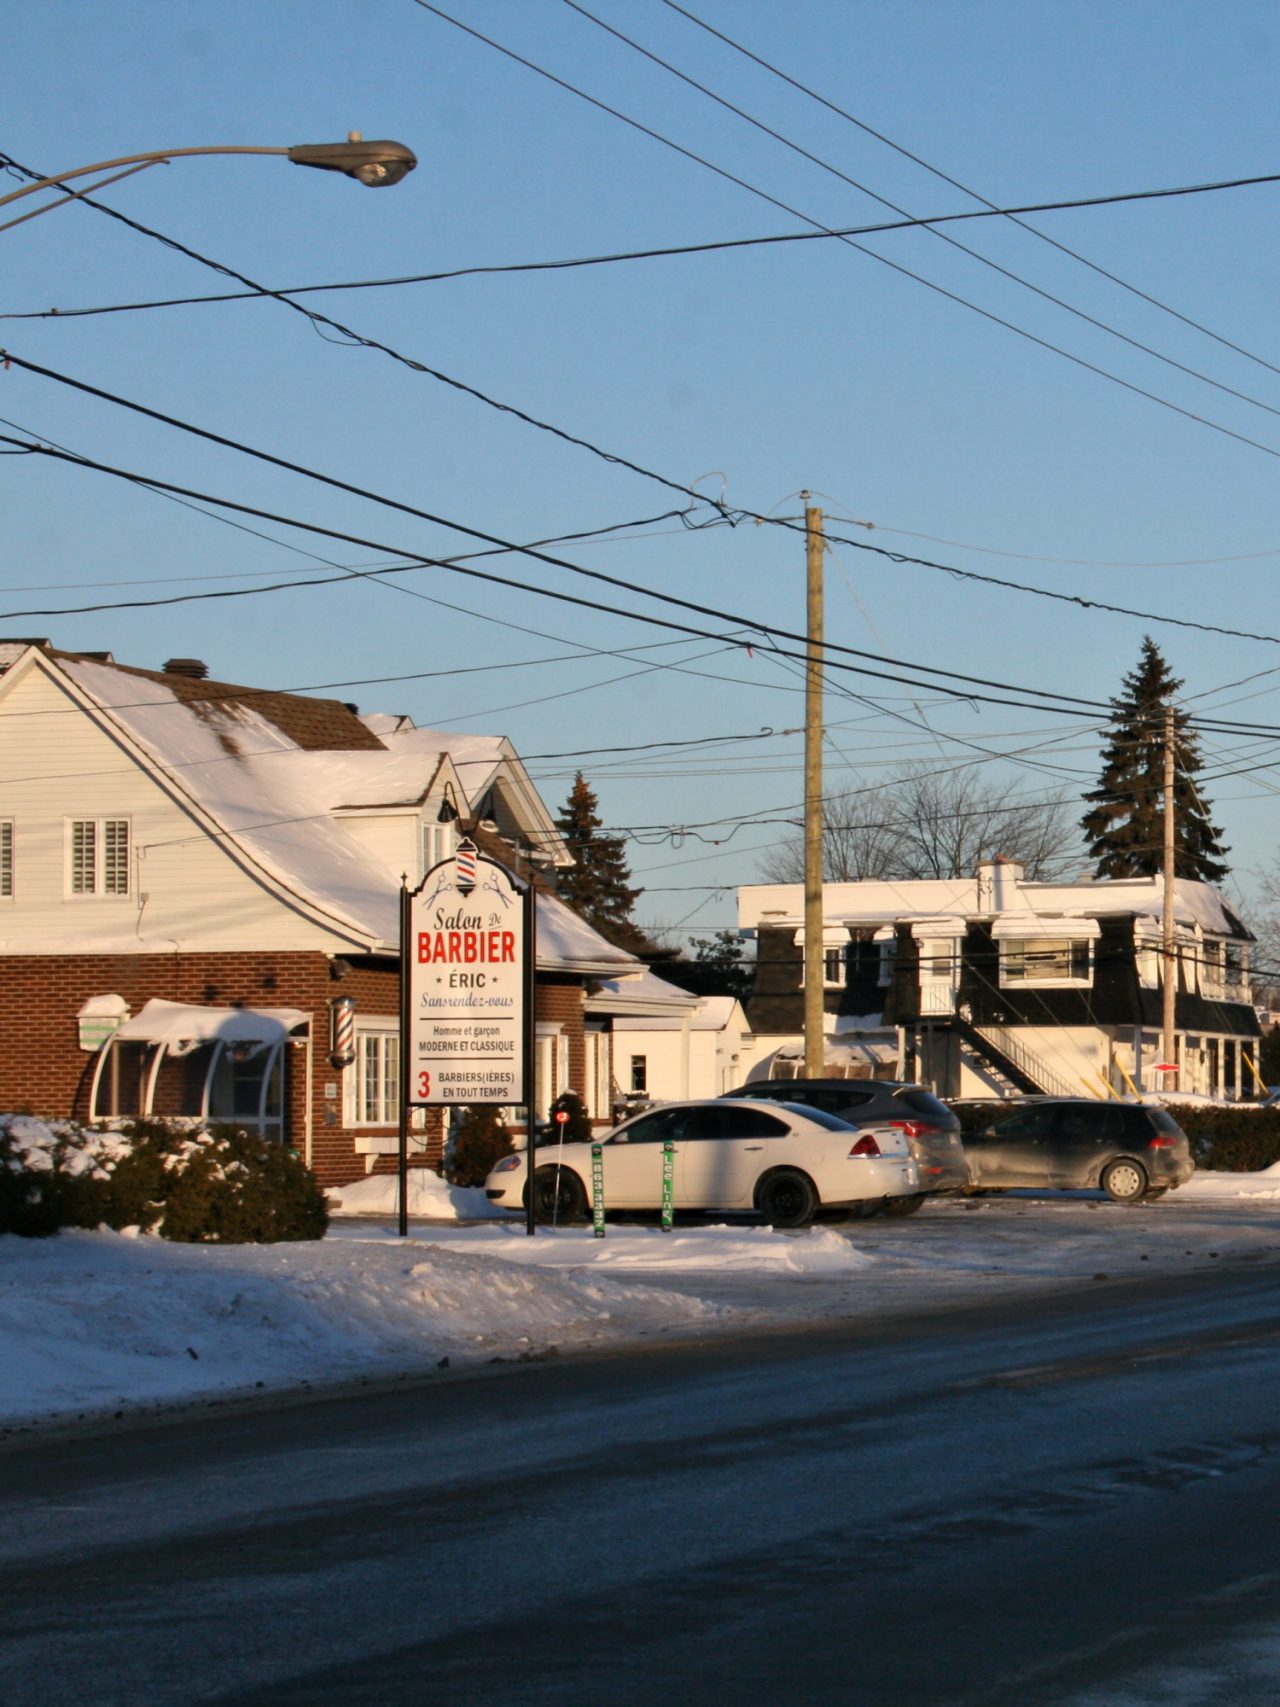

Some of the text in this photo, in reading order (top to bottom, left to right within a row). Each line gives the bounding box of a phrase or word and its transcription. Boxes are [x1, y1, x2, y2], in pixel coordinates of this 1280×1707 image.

[433, 907, 502, 930] Salon De
[417, 931, 515, 964] BARBIER
[449, 969, 486, 988] ÉRIC
[433, 1026, 500, 1038] Homme et garçon
[419, 1041, 514, 1052] MODERNE ET CLASSIQUE
[417, 1071, 431, 1098] 3
[443, 1087, 508, 1097] EN TOUT TEMPS
